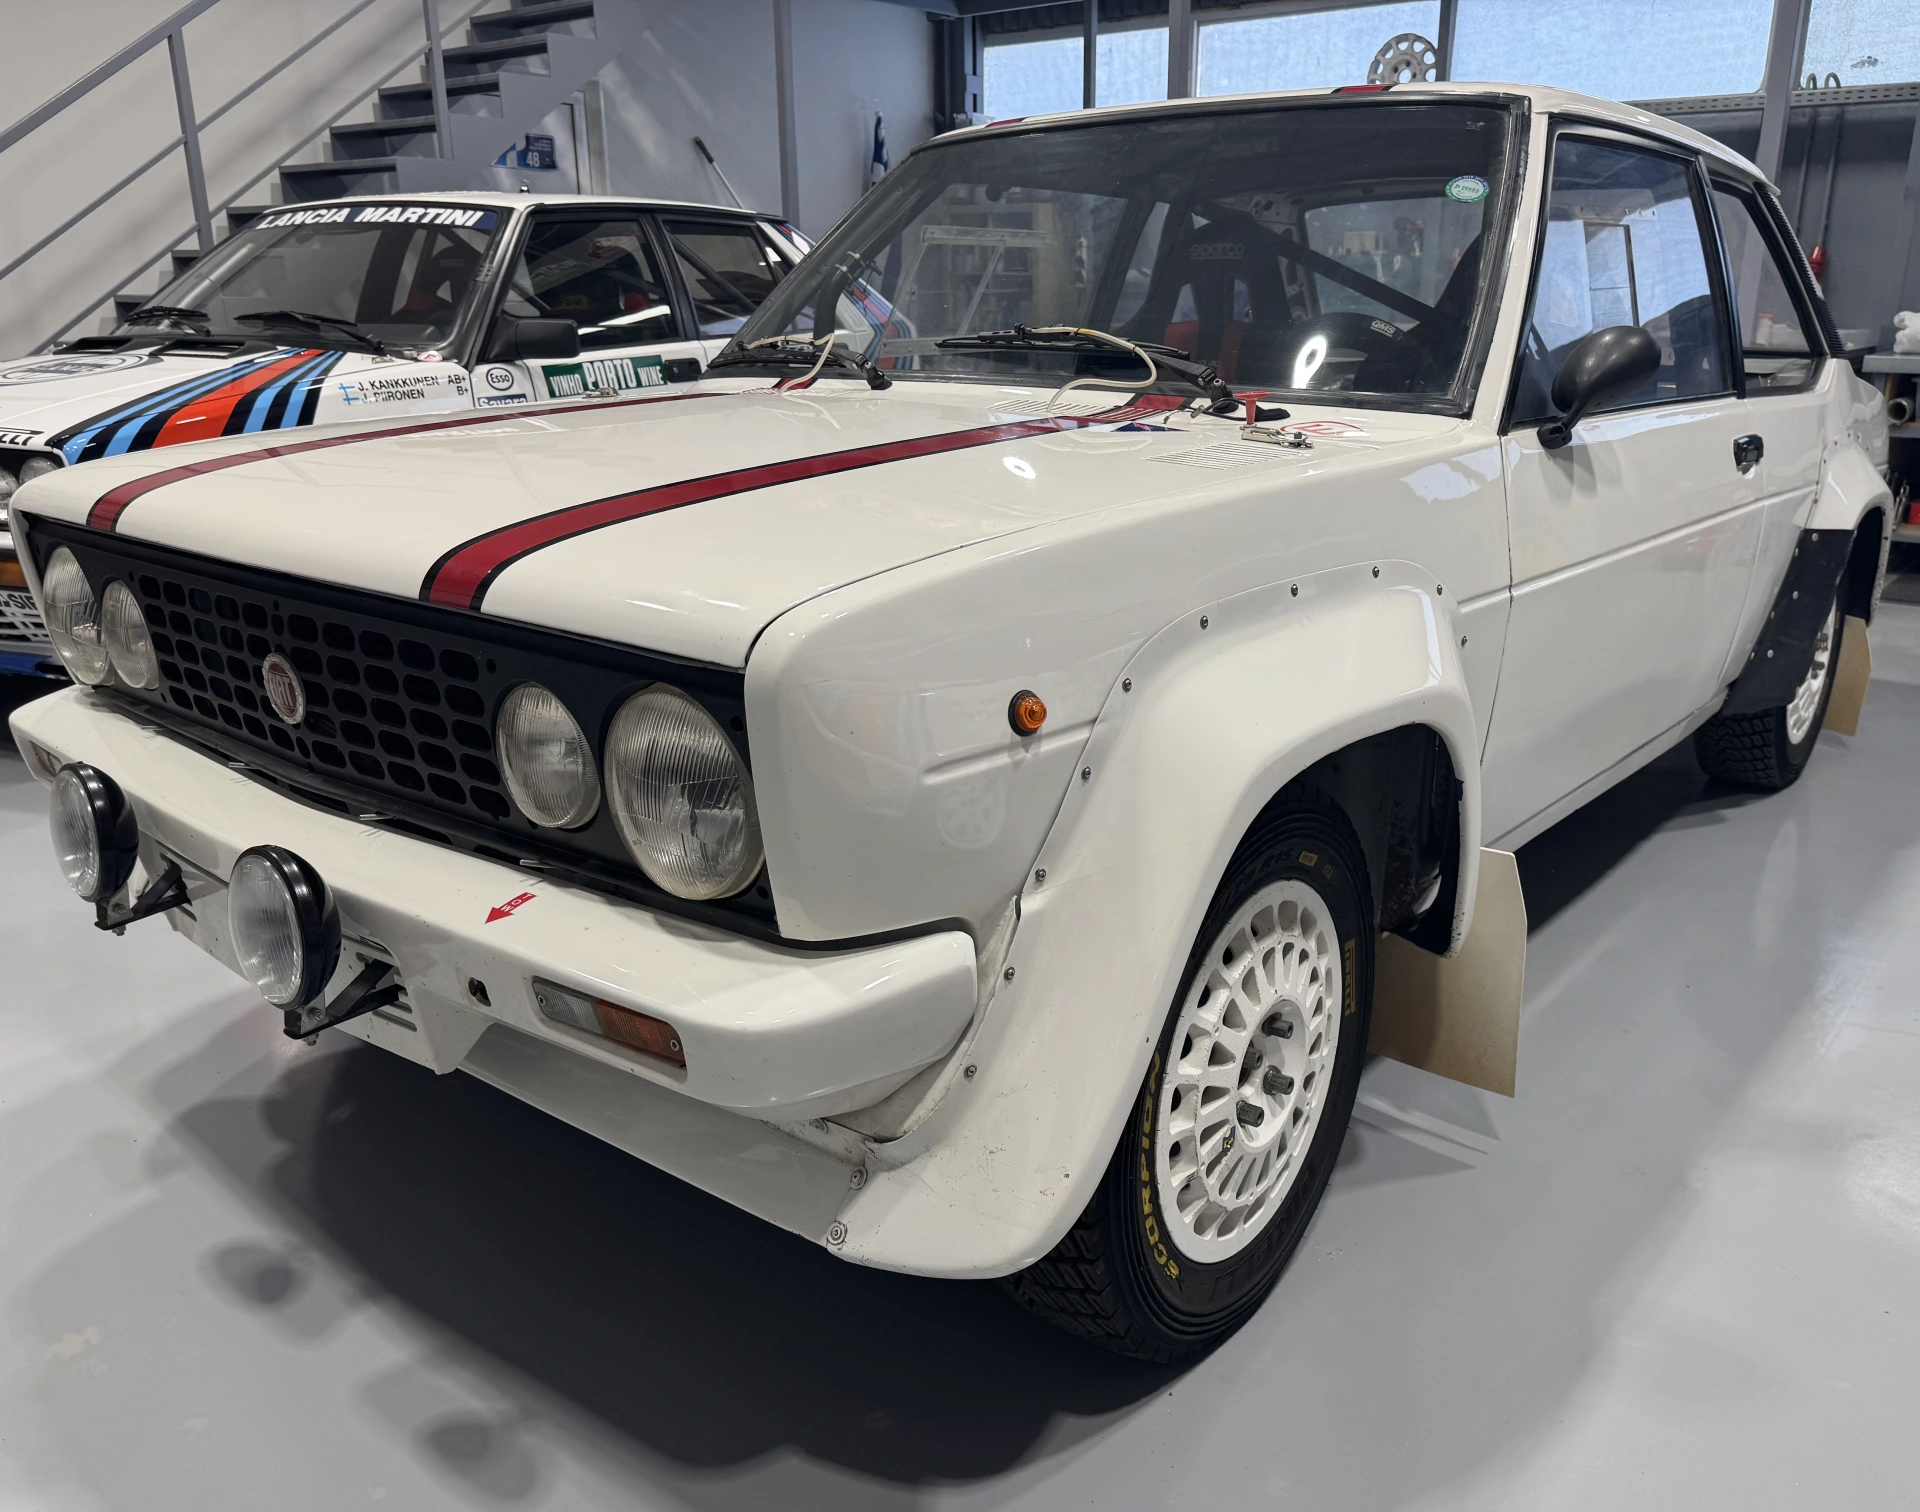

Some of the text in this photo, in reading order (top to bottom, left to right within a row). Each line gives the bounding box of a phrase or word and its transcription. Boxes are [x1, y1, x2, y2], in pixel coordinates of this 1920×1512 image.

[526, 151, 540, 168] 48
[256, 207, 485, 229] LANCIA MARTINI
[1190, 243, 1246, 260] sparco
[358, 375, 467, 391] J. KANKKUNEN AB+
[489, 368, 511, 384] Esso
[549, 358, 665, 397] VINHO PORTO WINE
[362, 386, 469, 403] J. PIIRONEN B+
[266, 671, 294, 707] FIAT
[500, 893, 534, 912] TOW
[1344, 938, 1356, 1017] PIRELLI
[1141, 1051, 1181, 1280] SCORPION
